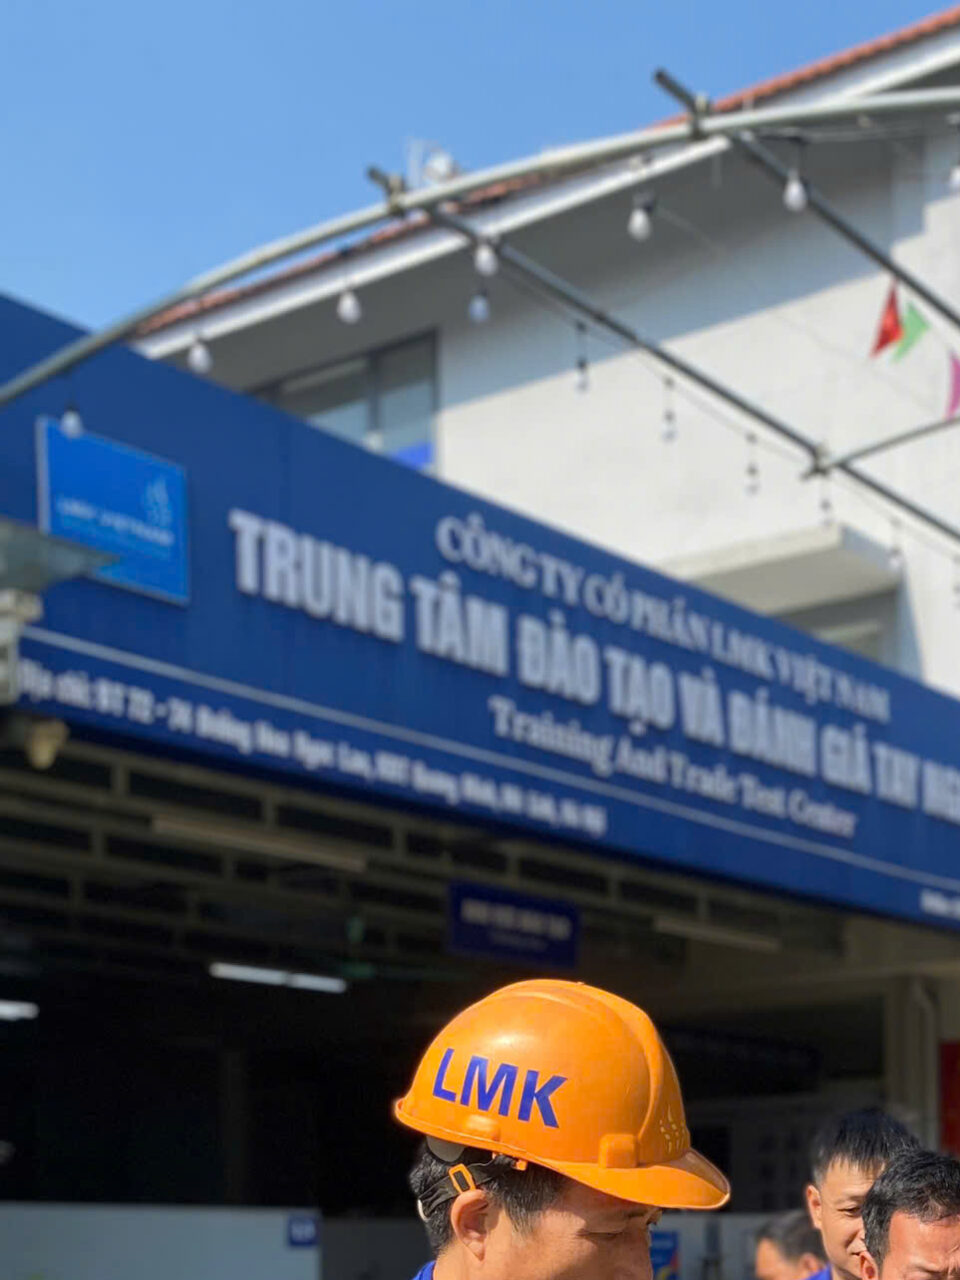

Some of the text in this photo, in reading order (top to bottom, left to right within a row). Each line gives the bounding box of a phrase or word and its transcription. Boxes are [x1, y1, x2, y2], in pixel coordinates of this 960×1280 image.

[228, 508, 404, 643] TRUNG
[410, 570, 509, 678] TÂM
[518, 608, 600, 706] ĐÀO
[603, 646, 675, 737] TẠO
[678, 666, 726, 747] VÀ
[727, 686, 816, 778] ĐÁNH
[872, 740, 919, 811] TAY
[435, 512, 538, 590] CÔNG
[538, 551, 586, 606] TY
[834, 669, 891, 724] NAM
[489, 694, 857, 839] Training And Trade Test Center
[433, 1047, 568, 1129] LMK
